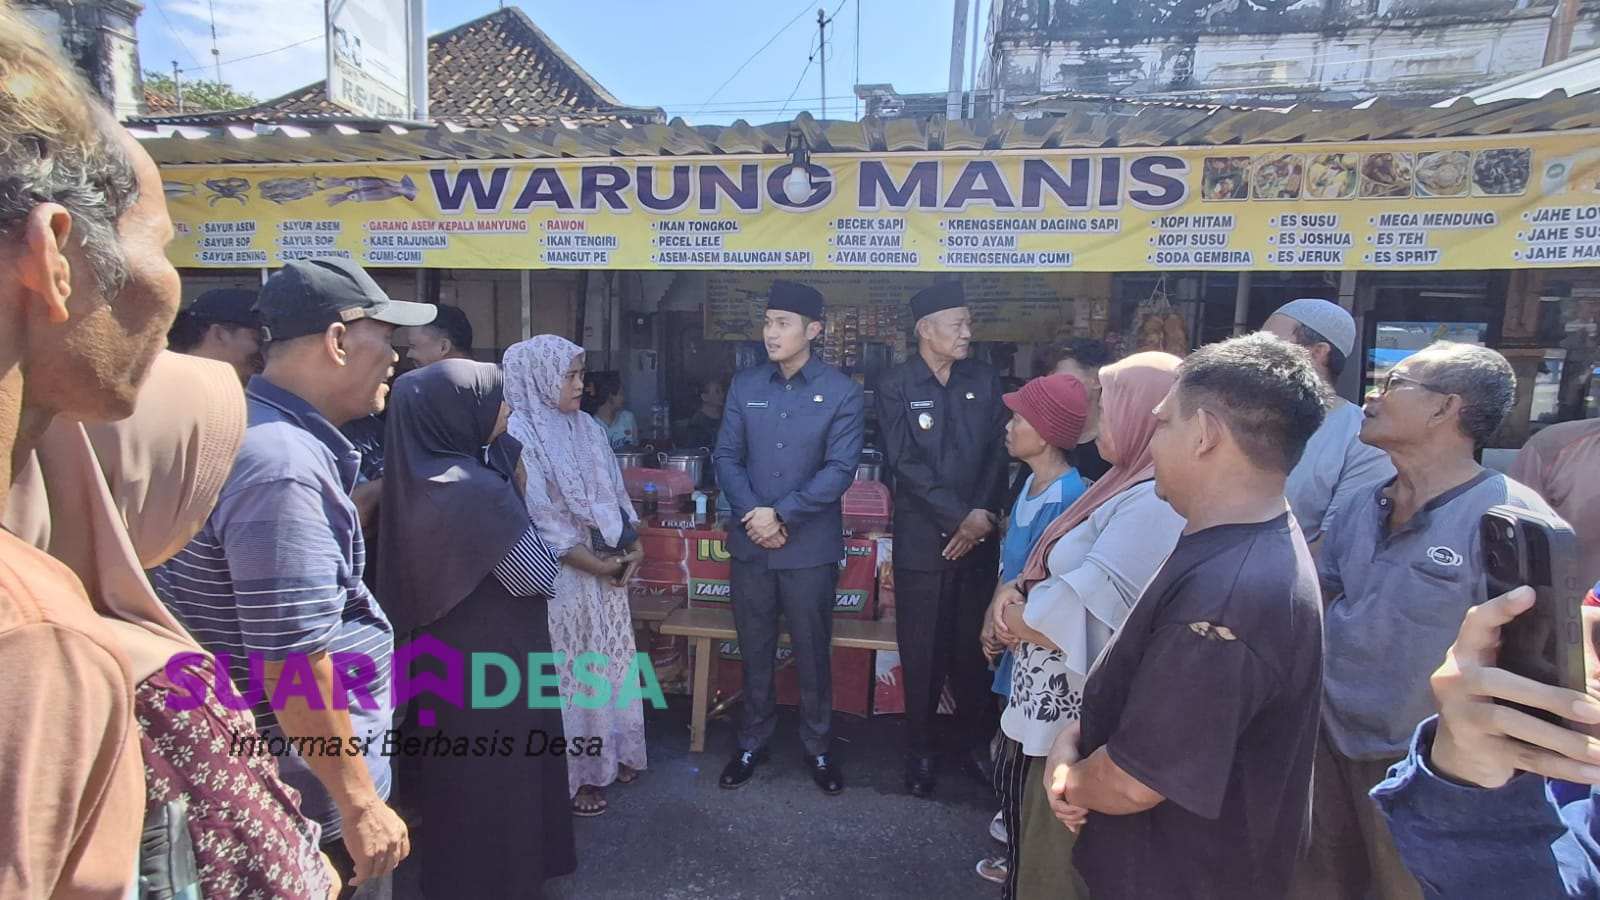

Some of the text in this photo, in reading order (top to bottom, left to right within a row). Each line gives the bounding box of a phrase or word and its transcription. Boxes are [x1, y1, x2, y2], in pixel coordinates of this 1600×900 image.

[429, 156, 1188, 210] WARUNG MANIS
[1379, 213, 1495, 226] MEGA MENDUNG
[1532, 206, 1600, 222] JAHE LO
[283, 221, 340, 231] SAYUR ASEM
[369, 220, 526, 231] GARANG ASEM KEPALA MANYUNG
[547, 220, 585, 230] RAWON
[659, 220, 738, 231] IKAN TONGKOL
[838, 219, 904, 230] BECEK SAPI
[949, 218, 1119, 230] KRENGSENGAN DAGING SAPI
[1160, 216, 1232, 228] KOPI HITAM
[1280, 215, 1336, 226] ES SUSU
[205, 221, 256, 233] SAYUR ASEM
[836, 235, 900, 246] KARE AYAM
[1158, 234, 1226, 246] KOPI SUSU
[1279, 233, 1351, 245] ES JOSHUA
[1377, 233, 1424, 245] ES TEH
[1527, 228, 1569, 242] JAHE
[204, 237, 251, 247] SAYUR SOP
[282, 236, 334, 246] SAYUR SOP
[370, 236, 447, 246] KARE RAJUNGAN
[547, 236, 617, 247] IKAN TENGIRI
[659, 236, 720, 247] PECEL LELE
[948, 236, 1014, 247] SOTO AYAM
[202, 251, 267, 261] SAYUR BENING
[369, 251, 422, 261] CUMI-CUMI
[547, 252, 607, 262] MANGUT PE
[659, 252, 810, 263] ASEM-ASEM BALUNGAN SAPI
[836, 252, 918, 263] AYAM GORENG
[1156, 252, 1250, 263] SODA GEMBIRA
[1277, 251, 1341, 262] ES JERUK
[1374, 250, 1437, 262] ES SPRIT
[1525, 246, 1567, 259] JAHE
[947, 253, 1070, 264] KRENGSENGAN CUMI
[696, 583, 731, 597] TANP
